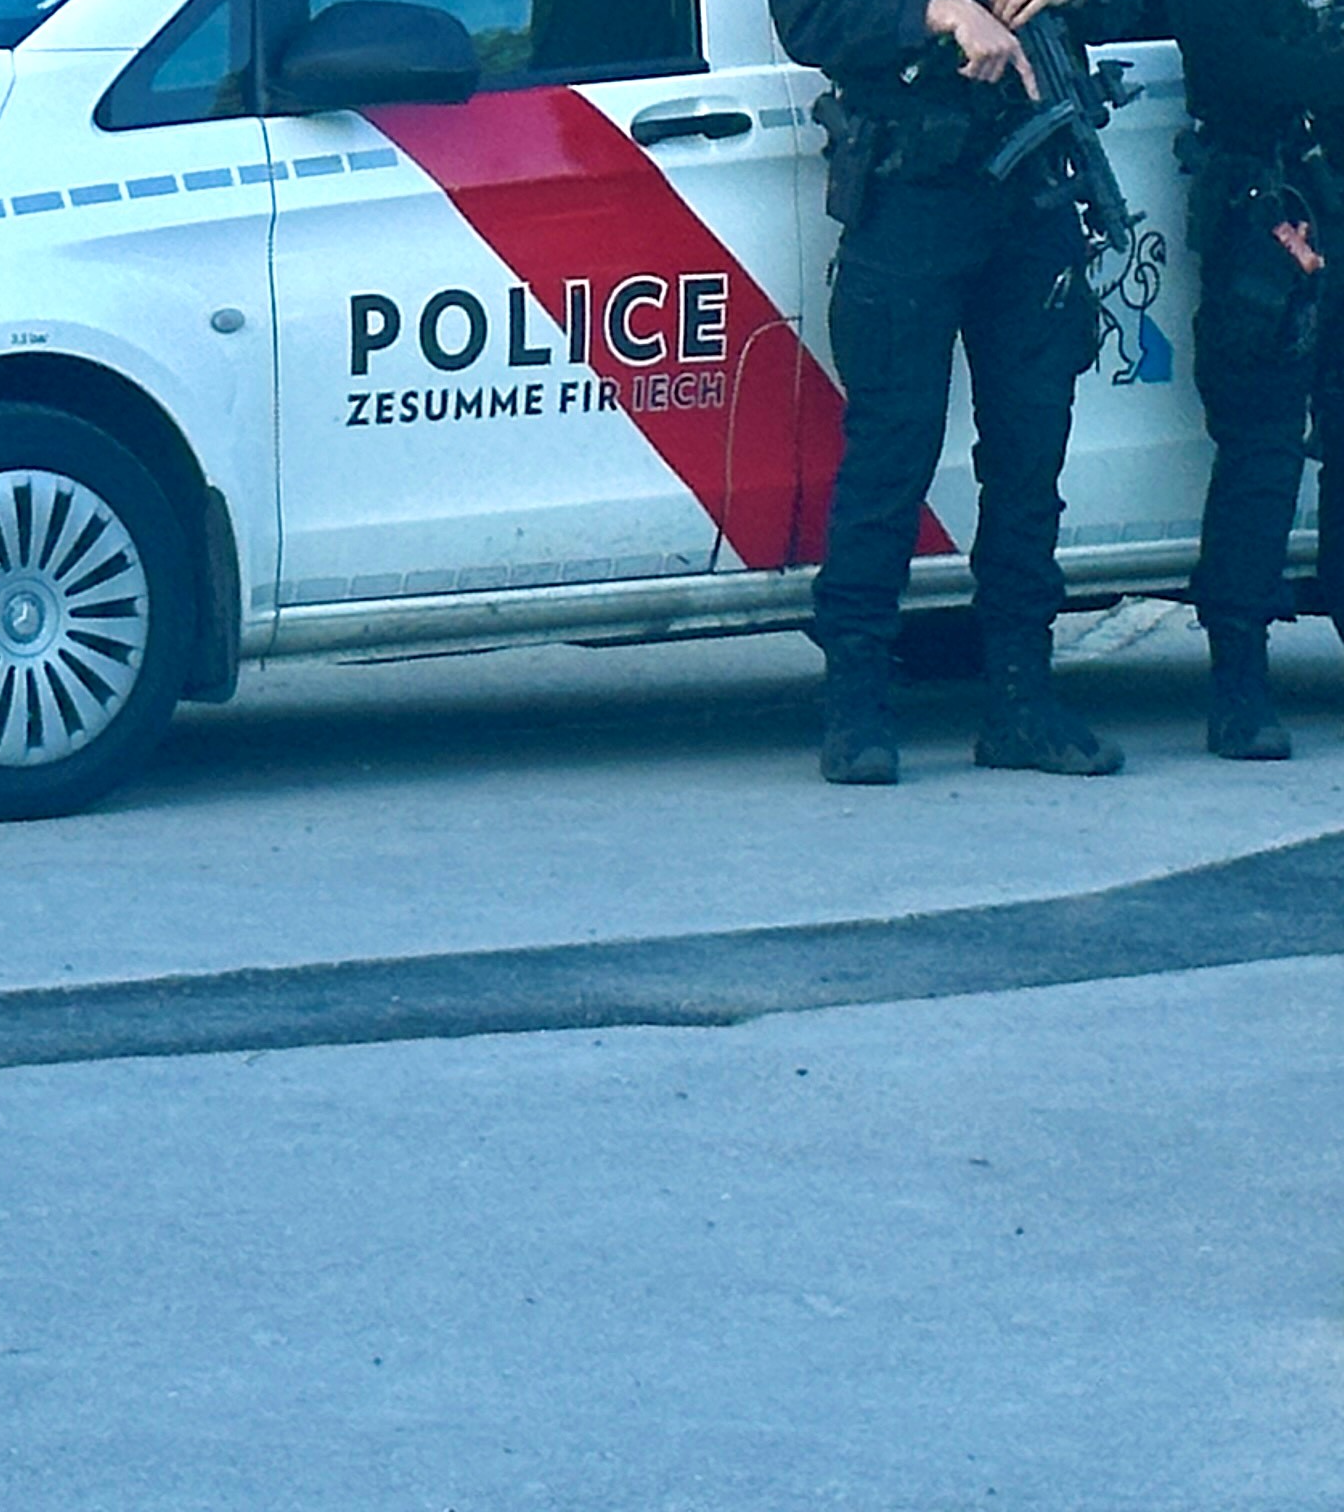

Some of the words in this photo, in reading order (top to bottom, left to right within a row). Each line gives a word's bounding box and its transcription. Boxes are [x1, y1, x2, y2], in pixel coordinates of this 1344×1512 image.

[348, 273, 729, 376] POLICE
[345, 382, 544, 427] ZESUMME
[558, 375, 621, 414] FIR
[631, 371, 727, 412] IECH
